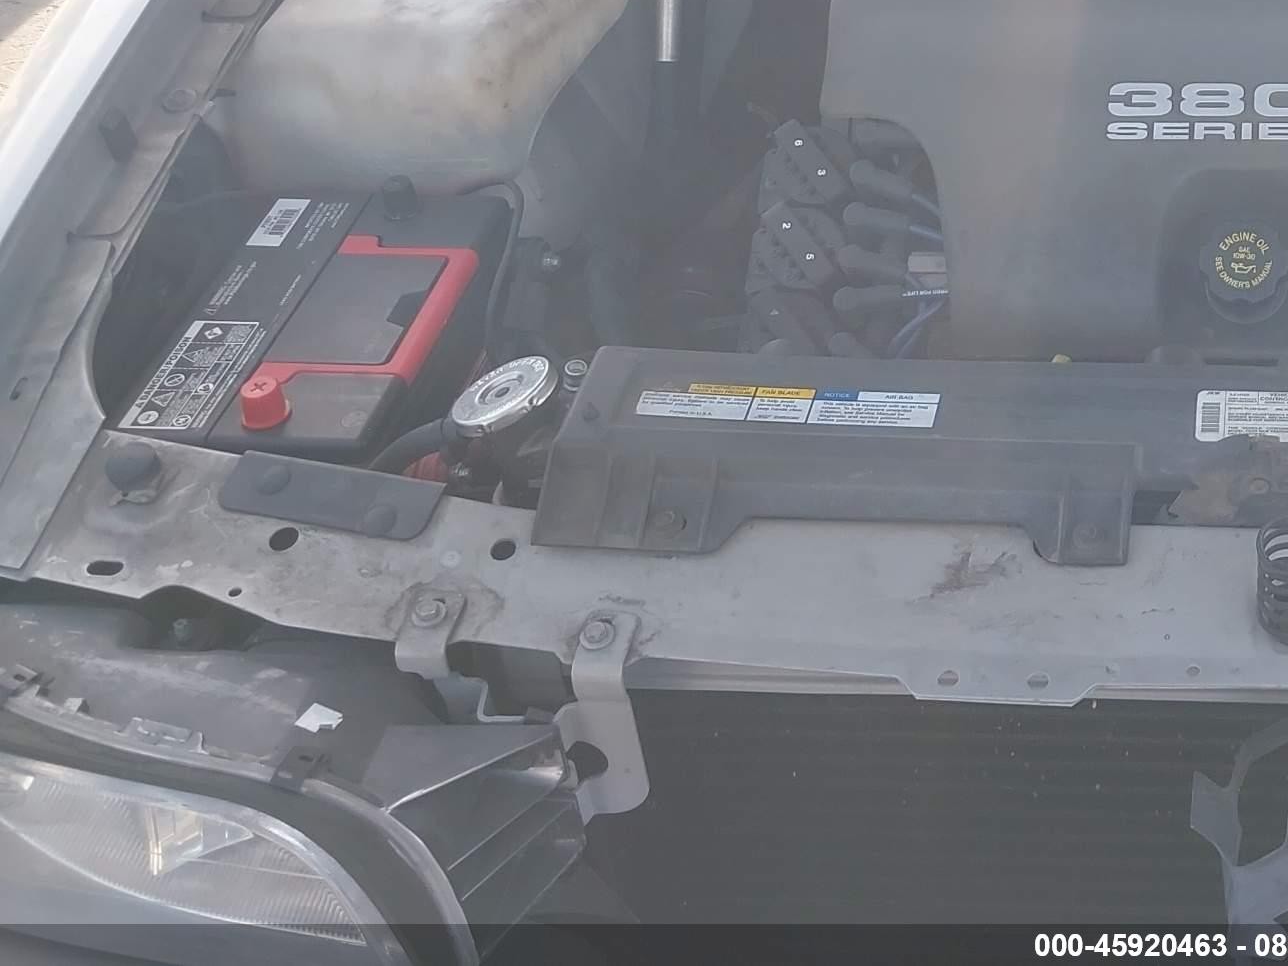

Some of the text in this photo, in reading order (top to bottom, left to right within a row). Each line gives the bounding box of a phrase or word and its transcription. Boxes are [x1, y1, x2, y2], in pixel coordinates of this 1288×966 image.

[794, 139, 804, 147] 6
[782, 222, 792, 230] 2
[1219, 231, 1270, 255] ENGINE OIL
[805, 253, 815, 261] 5
[1215, 256, 1273, 288] SEE OWNER'S MANUAL
